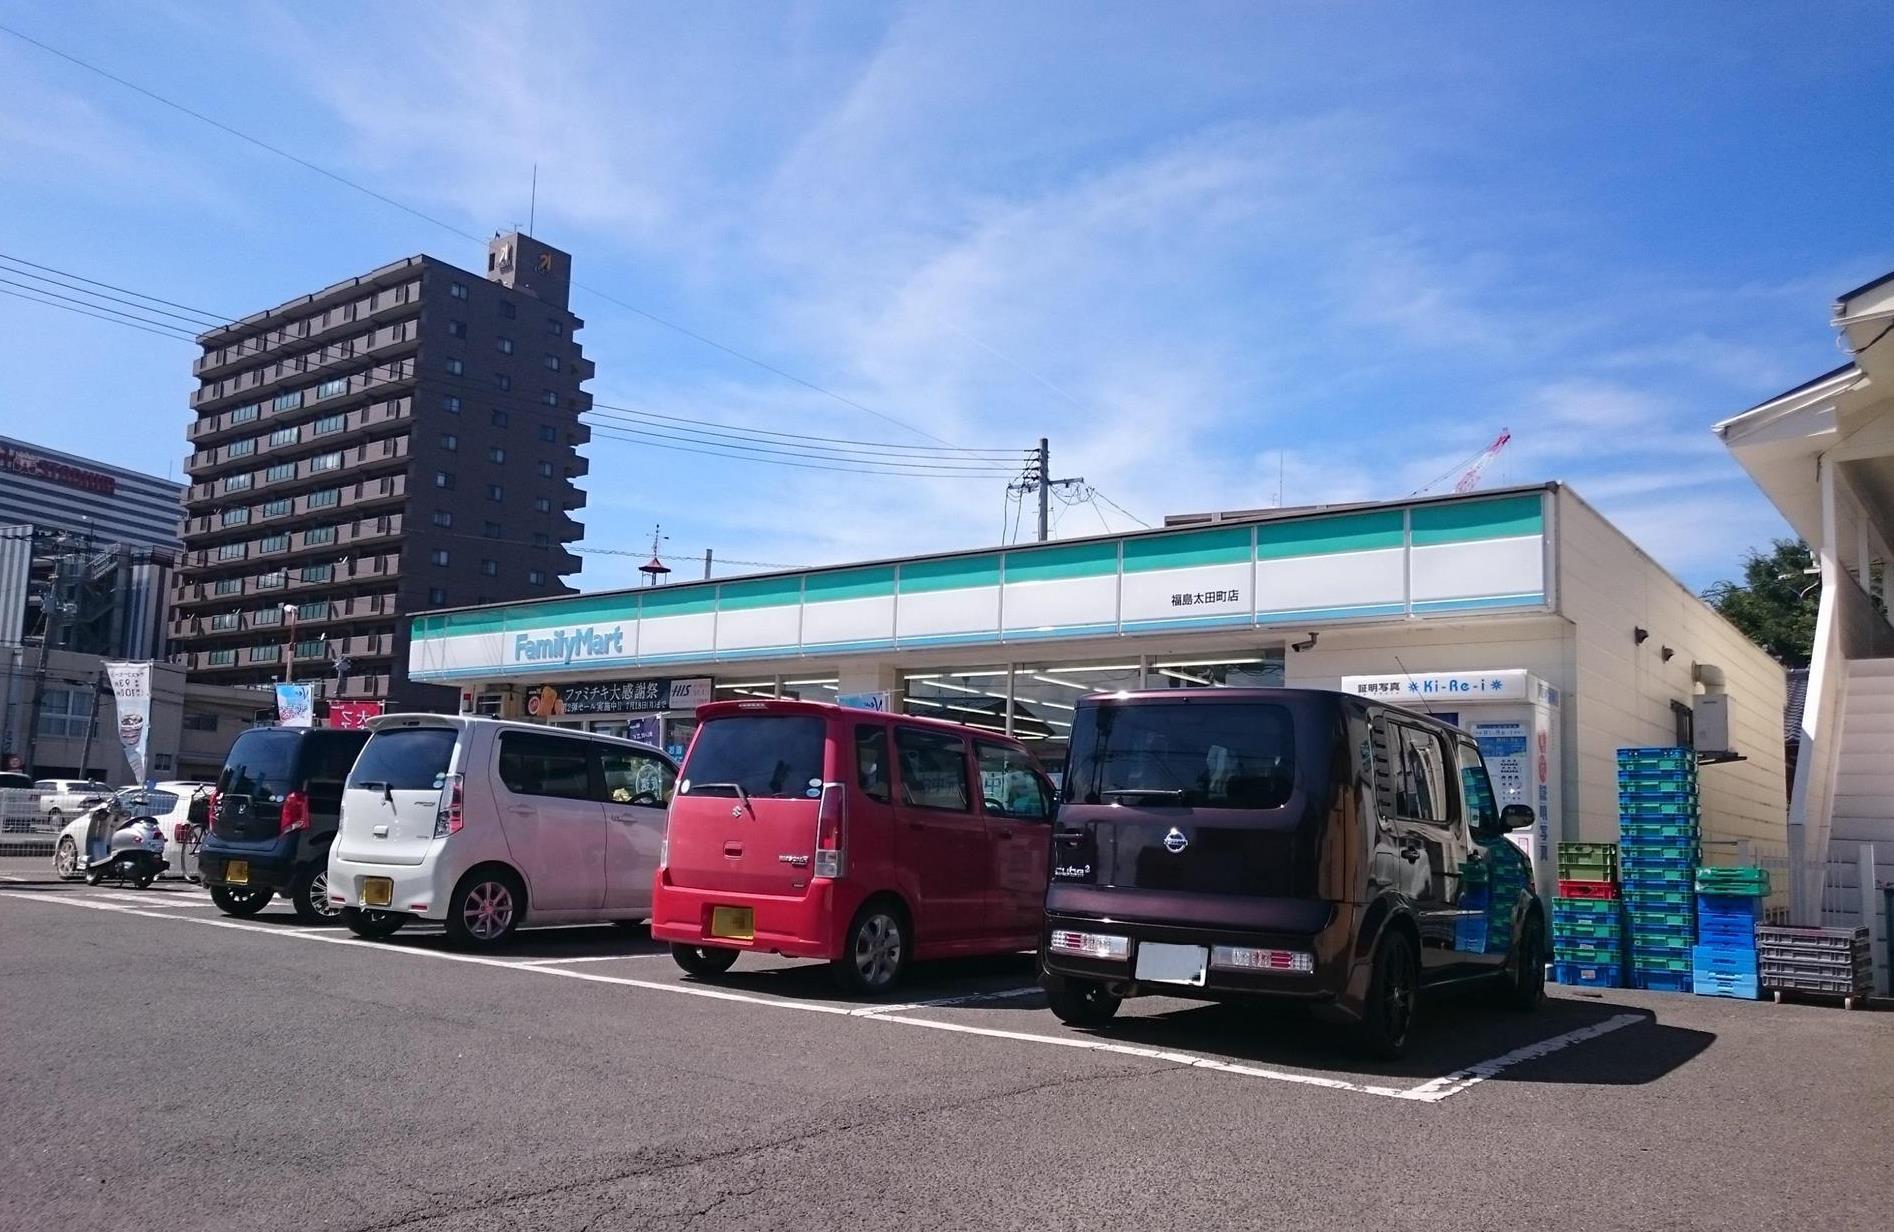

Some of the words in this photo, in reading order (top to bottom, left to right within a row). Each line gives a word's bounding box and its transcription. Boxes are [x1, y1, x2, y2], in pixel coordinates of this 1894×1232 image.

[1171, 589, 1239, 606] 福島太田町店
[515, 625, 623, 665] FamilyMart
[566, 682, 658, 700] ファミチキ大感謝祭
[671, 685, 692, 697] HIS
[1358, 682, 1400, 693] 証明写真
